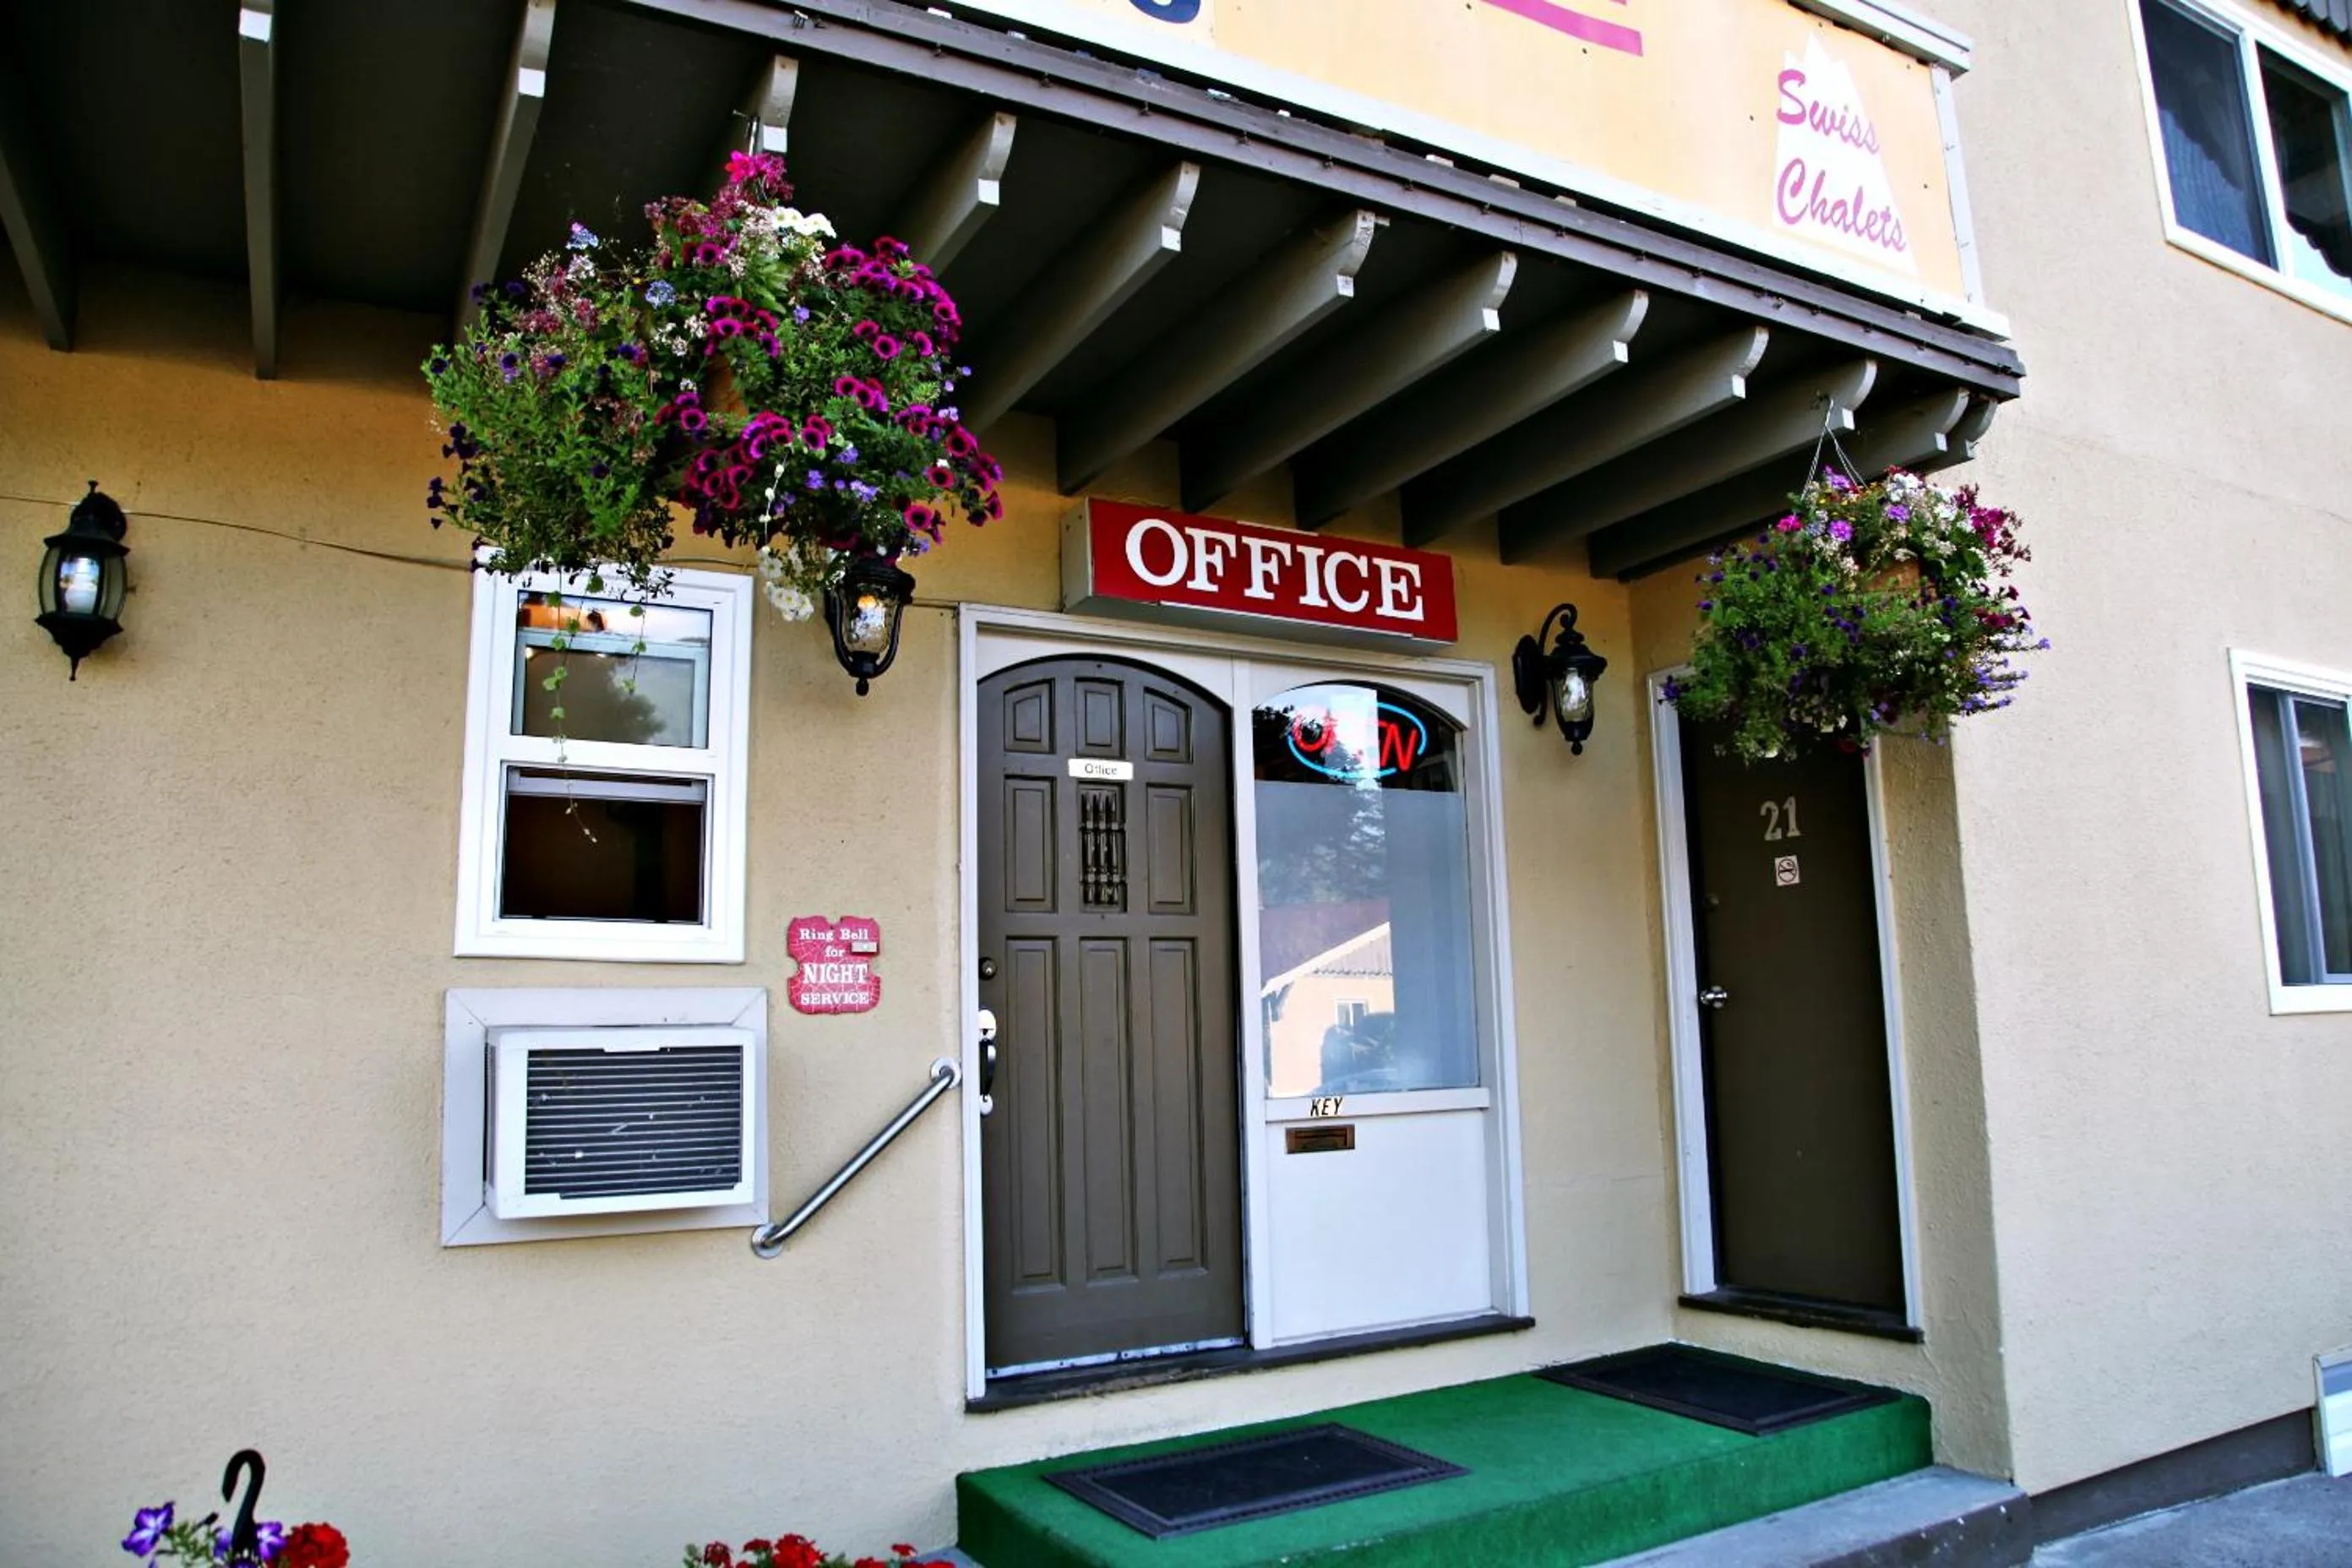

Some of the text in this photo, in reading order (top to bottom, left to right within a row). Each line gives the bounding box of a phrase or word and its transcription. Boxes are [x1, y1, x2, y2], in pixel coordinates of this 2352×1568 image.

[1777, 68, 1880, 155] Swiss
[1777, 157, 1907, 252] Chalets
[1125, 518, 1425, 621] OFFICE
[1760, 795, 1801, 841] 21
[799, 928, 868, 941] Ring Bell
[825, 945, 846, 957] for
[802, 962, 868, 983] NIGHT
[800, 991, 869, 1005] SERVICE
[1309, 1097, 1343, 1116] KEY
